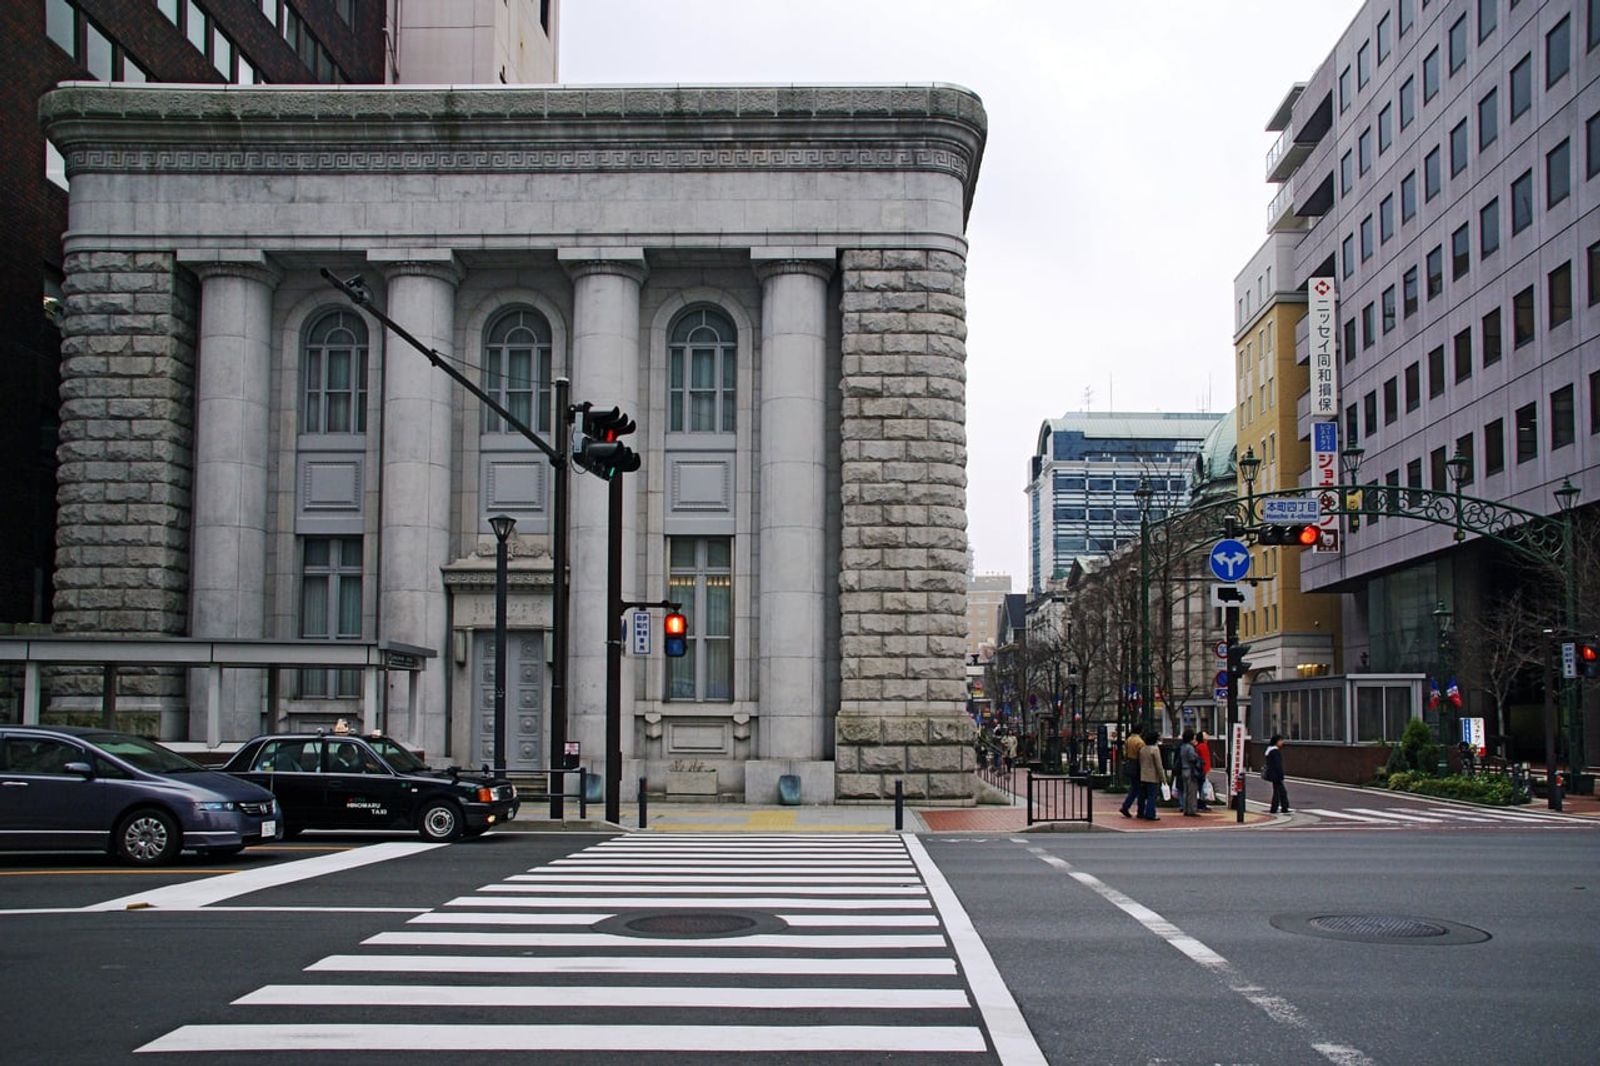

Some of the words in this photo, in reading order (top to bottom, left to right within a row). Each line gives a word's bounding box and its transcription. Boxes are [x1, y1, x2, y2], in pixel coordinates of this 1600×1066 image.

[1316, 299, 1332, 412] ニッセイ同和損保
[1267, 501, 1317, 512] 本町四丁目
